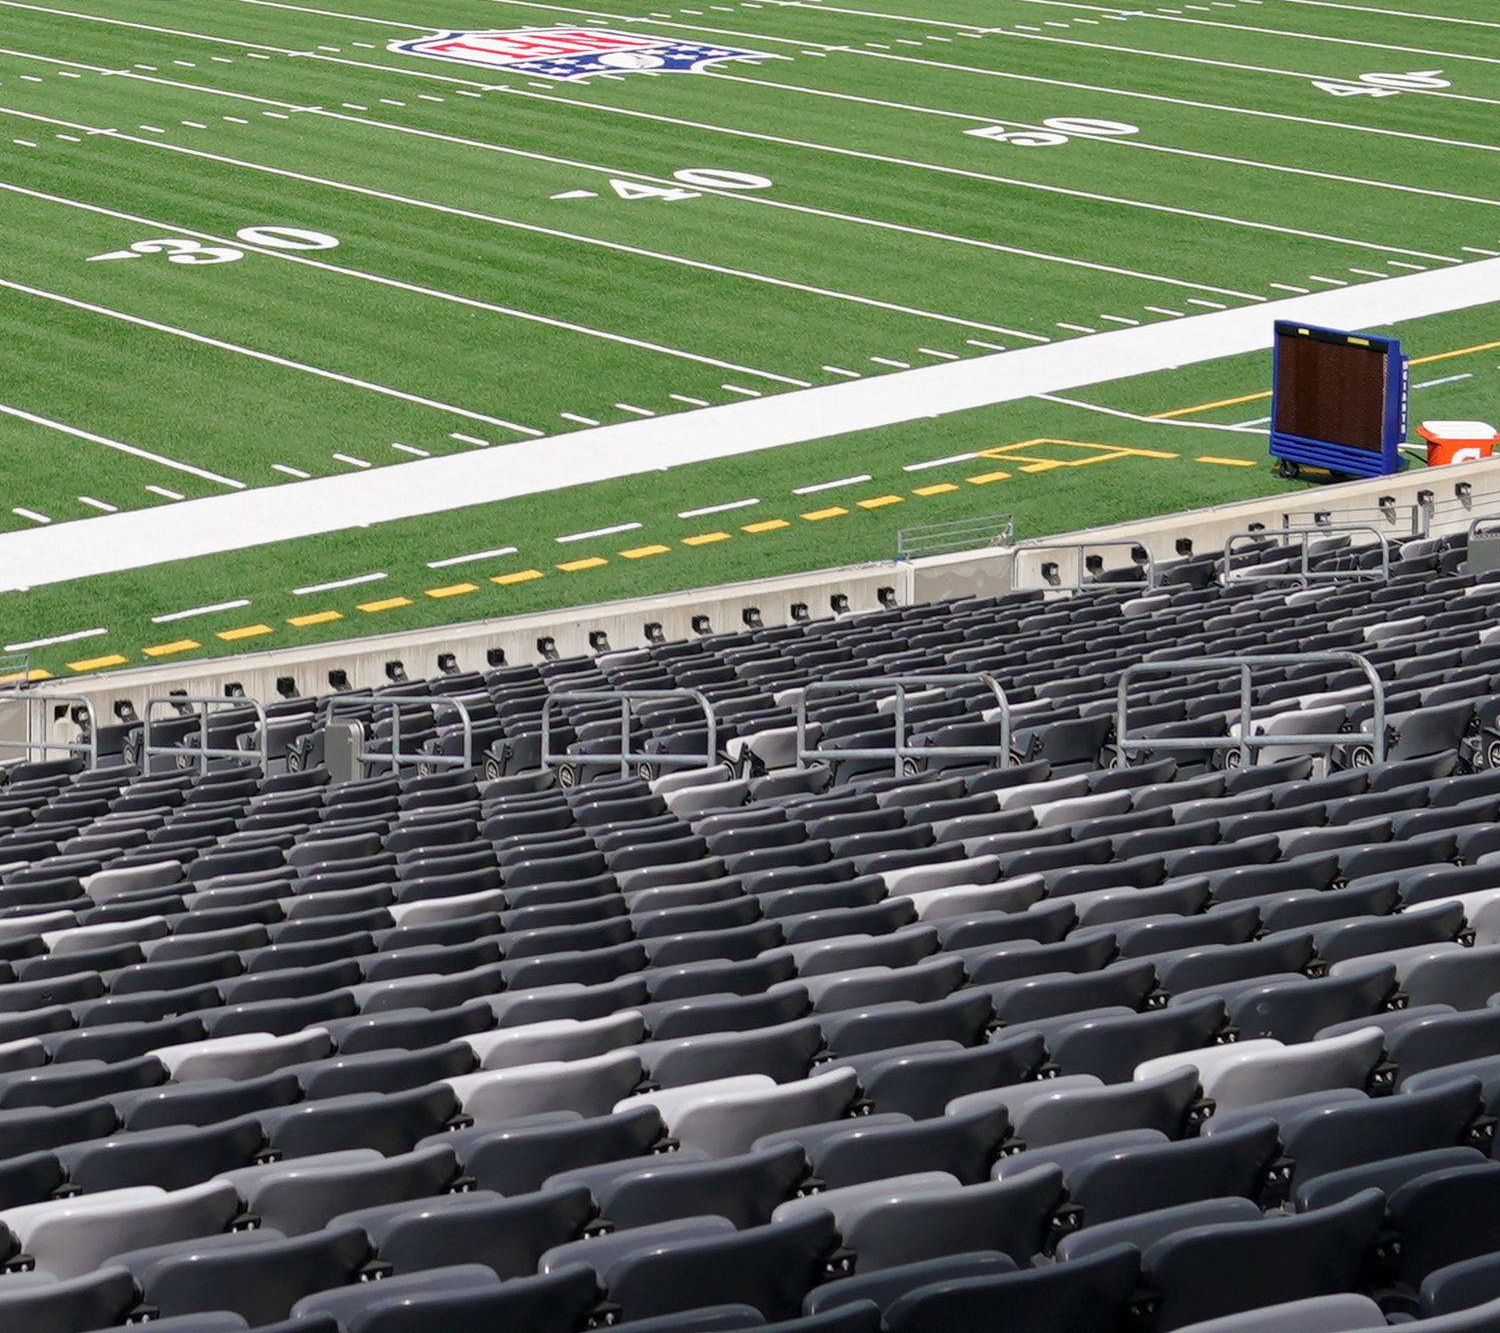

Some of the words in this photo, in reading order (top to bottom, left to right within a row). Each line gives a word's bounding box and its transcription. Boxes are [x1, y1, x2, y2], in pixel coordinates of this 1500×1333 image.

[1312, 72, 1451, 97] 40
[962, 117, 1139, 146] 50
[609, 168, 772, 201] 40
[130, 226, 339, 264] 30
